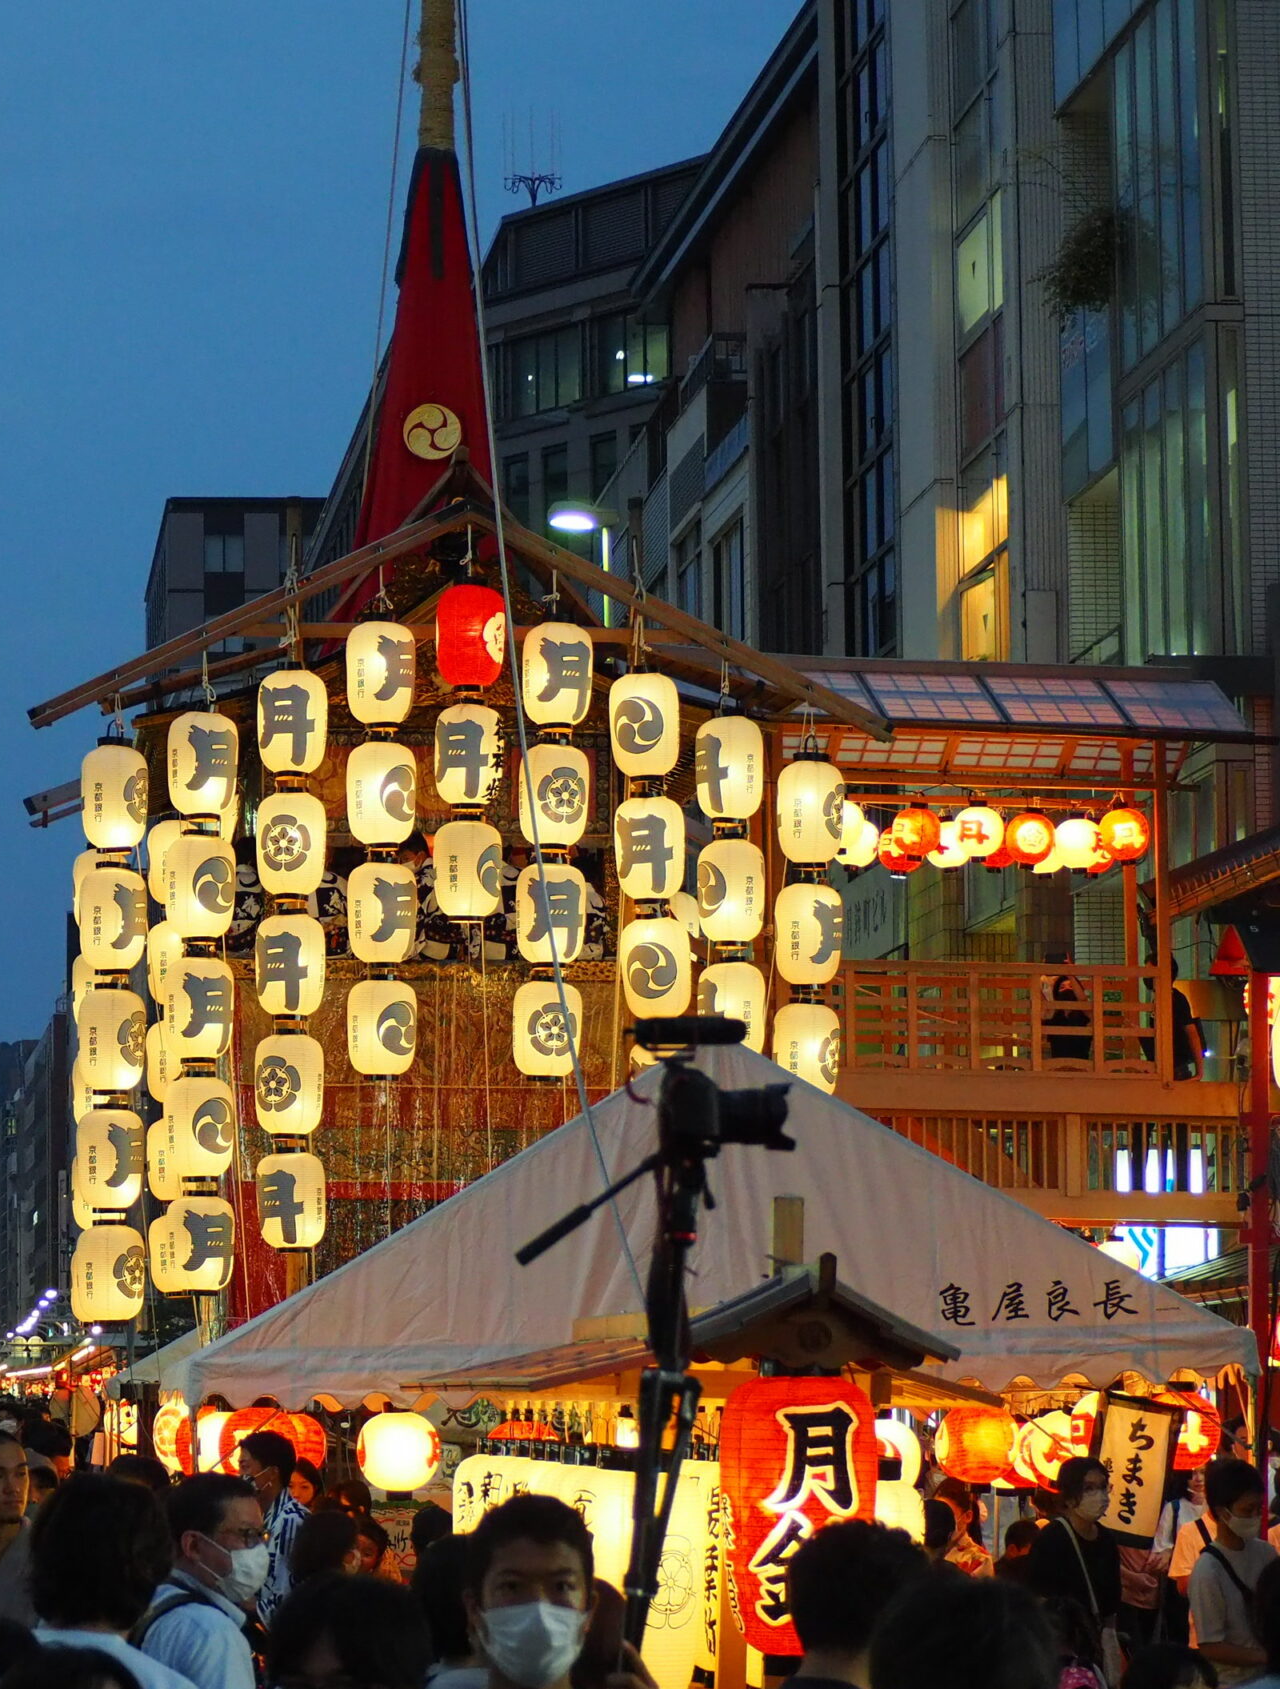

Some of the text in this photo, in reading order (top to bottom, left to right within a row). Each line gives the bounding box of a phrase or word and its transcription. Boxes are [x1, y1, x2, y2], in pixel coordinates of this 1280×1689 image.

[357, 658, 365, 698] 京都銀行
[536, 637, 592, 721] 月
[260, 684, 316, 766] 月
[435, 719, 489, 799] 月
[746, 754, 754, 793] 京都銀行
[94, 782, 103, 822] 京都銀行
[793, 799, 802, 839] 京都銀行
[960, 820, 989, 844] 月
[449, 855, 457, 892] 京都銀行
[616, 814, 674, 893] 月
[746, 876, 754, 916] 京都銀行
[93, 906, 102, 945] 京都銀行
[527, 877, 583, 959] 月
[791, 921, 800, 960] 京都銀行
[256, 932, 308, 1011] 月
[181, 972, 234, 1054] 月
[89, 1027, 97, 1066] 京都銀行
[88, 1145, 96, 1184] 京都銀行
[159, 1243, 167, 1273] 京都銀行
[182, 1210, 235, 1286] 月
[939, 1279, 1139, 1327] 亀屋良長
[1116, 1417, 1155, 1525] ちまき
